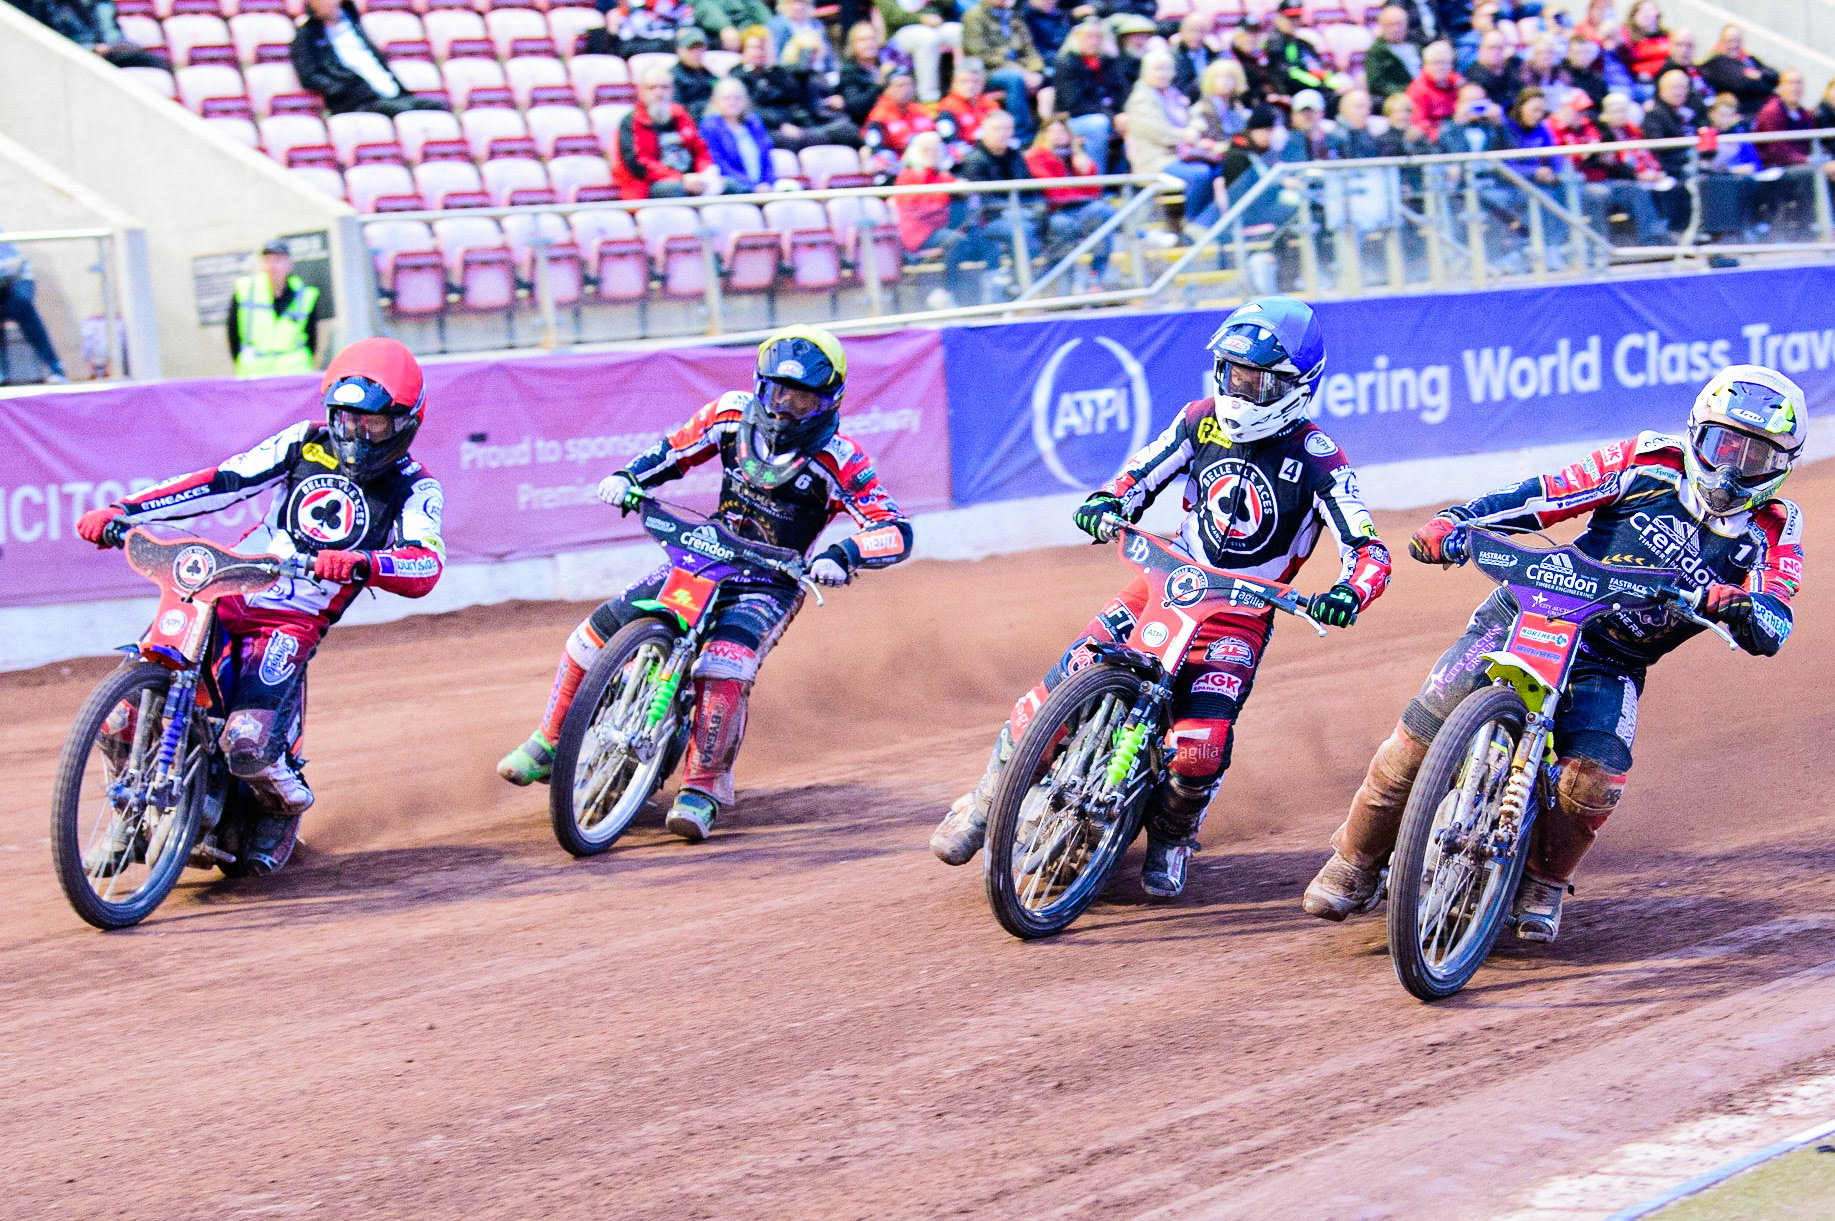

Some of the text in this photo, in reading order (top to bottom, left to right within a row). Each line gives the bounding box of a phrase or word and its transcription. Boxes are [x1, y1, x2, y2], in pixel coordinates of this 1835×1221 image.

[1462, 335, 1602, 403] World
[1613, 329, 1732, 389] Class
[1741, 323, 1835, 373] Trav
[1053, 384, 1130, 439] ATPI
[460, 436, 531, 470] Proud
[536, 439, 562, 462] to
[795, 474, 813, 490] 6
[1284, 461, 1299, 481] 4
[1202, 463, 1232, 487] BELLE
[1256, 484, 1272, 515] ACES
[301, 478, 334, 495] BELLE
[354, 499, 365, 526] ACES
[680, 531, 735, 559] Crendon
[1479, 551, 1510, 562] FASTRACK
[1639, 535, 1666, 560] TIMBER
[1735, 544, 1753, 561] 1
[1783, 559, 1801, 574] NG
[1526, 565, 1598, 594] Crendon
[1535, 582, 1594, 600] TIMBER ENGINEERING
[1610, 577, 1648, 593] FASTRACK
[1238, 590, 1265, 608] agilia
[1465, 641, 1497, 672] GROUP
[1444, 658, 1465, 684] CITY
[1195, 674, 1240, 693] NGK
[1179, 743, 1219, 764] agilia
